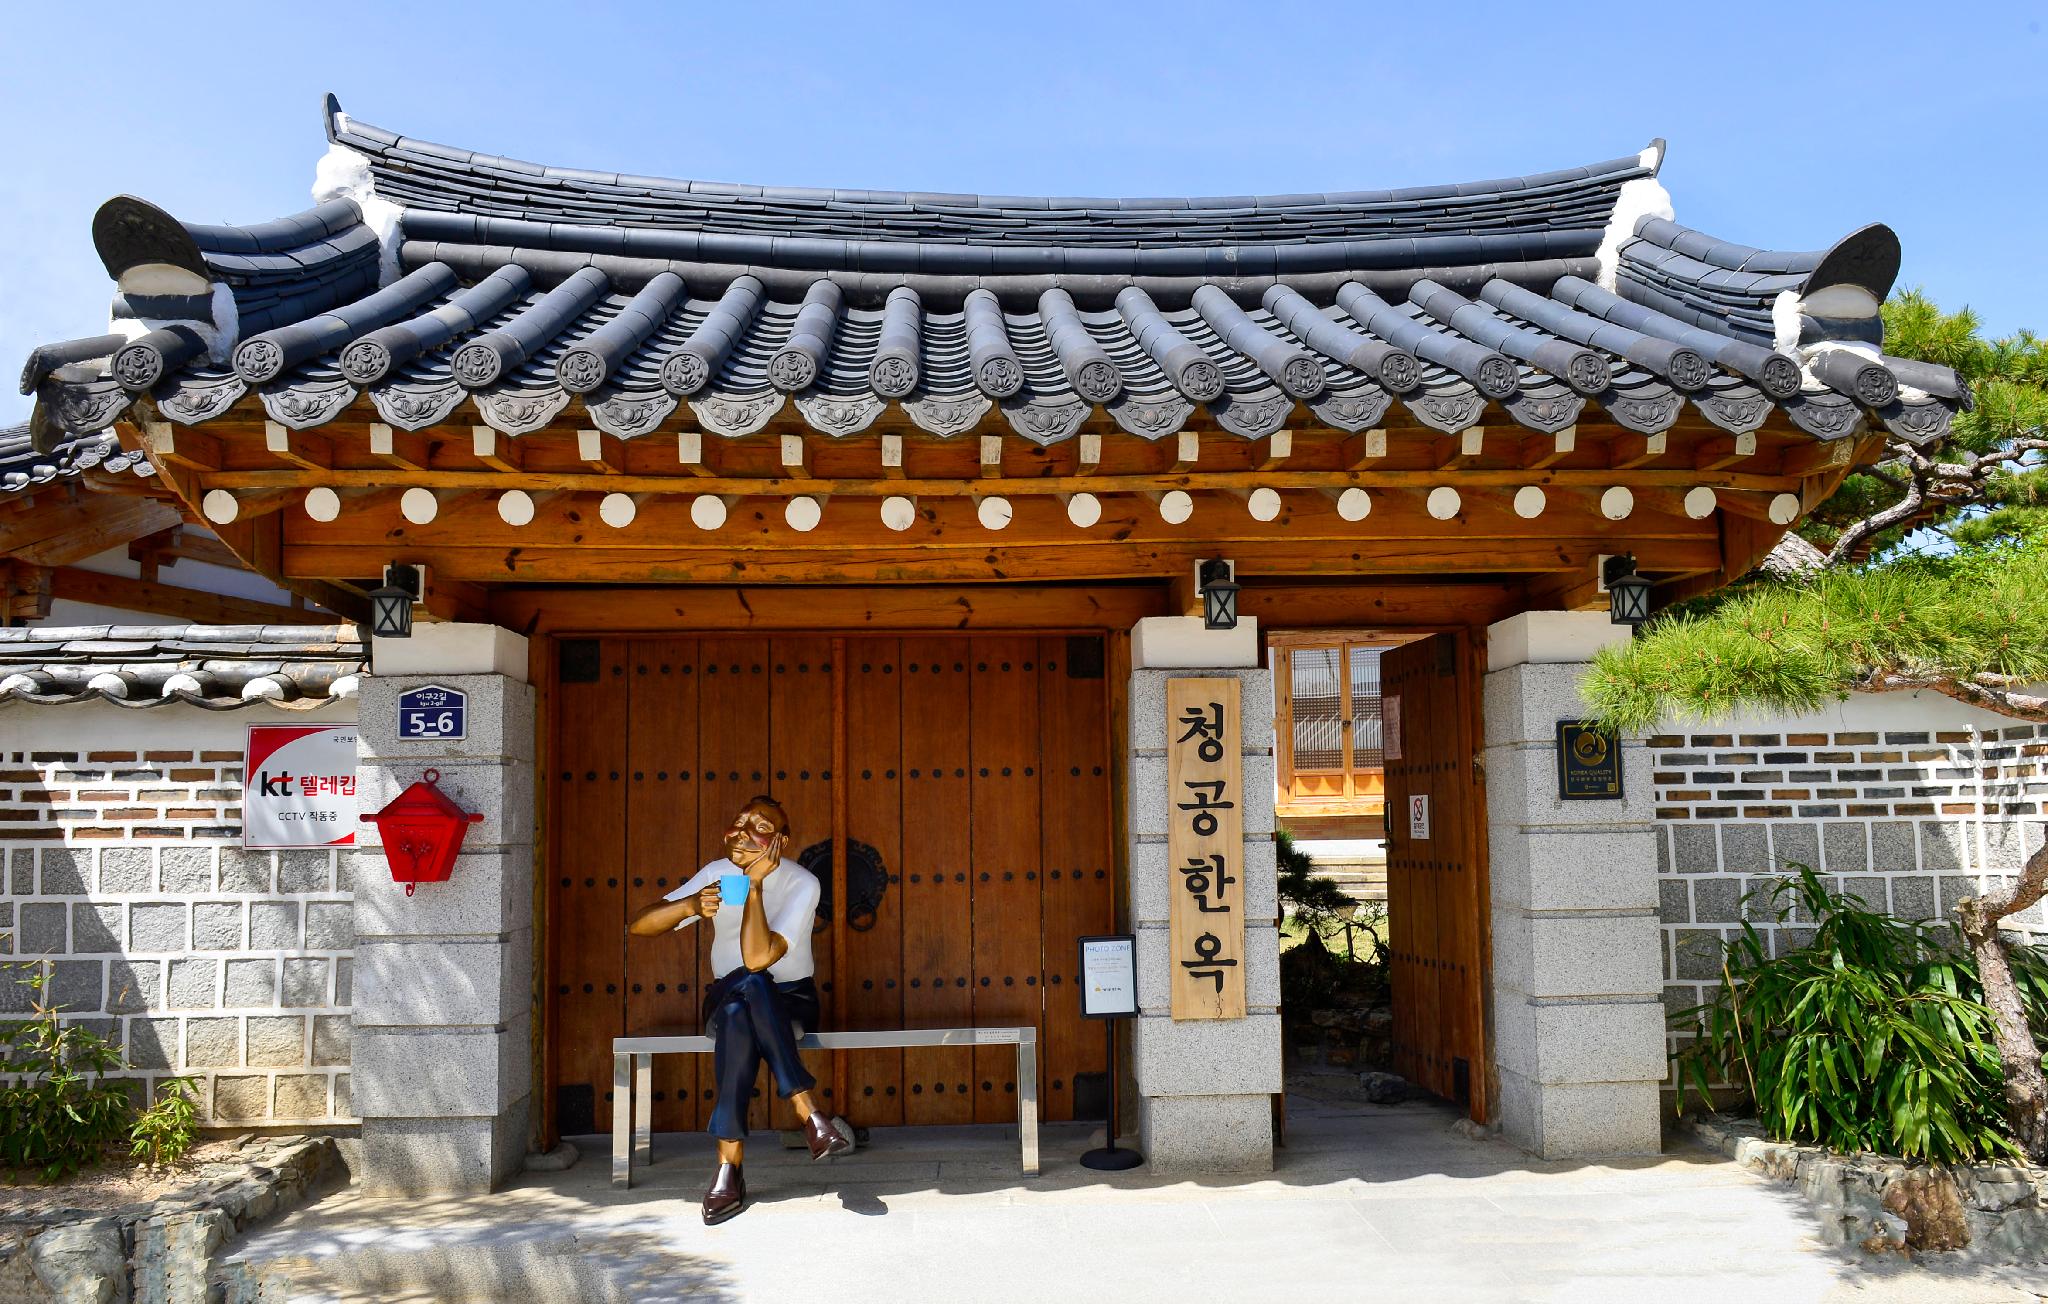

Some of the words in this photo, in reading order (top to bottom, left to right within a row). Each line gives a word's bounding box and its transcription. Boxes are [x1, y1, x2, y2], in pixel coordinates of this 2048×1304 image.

[416, 692, 447, 700] 이구2길
[410, 712, 454, 733] 5-6
[260, 771, 293, 796] kt
[300, 775, 356, 796] 텔레캅
[278, 812, 306, 820] CCTV
[309, 811, 338, 822] 작동중
[1176, 702, 1237, 994] 청공한옥
[1111, 944, 1130, 952] ZONE
